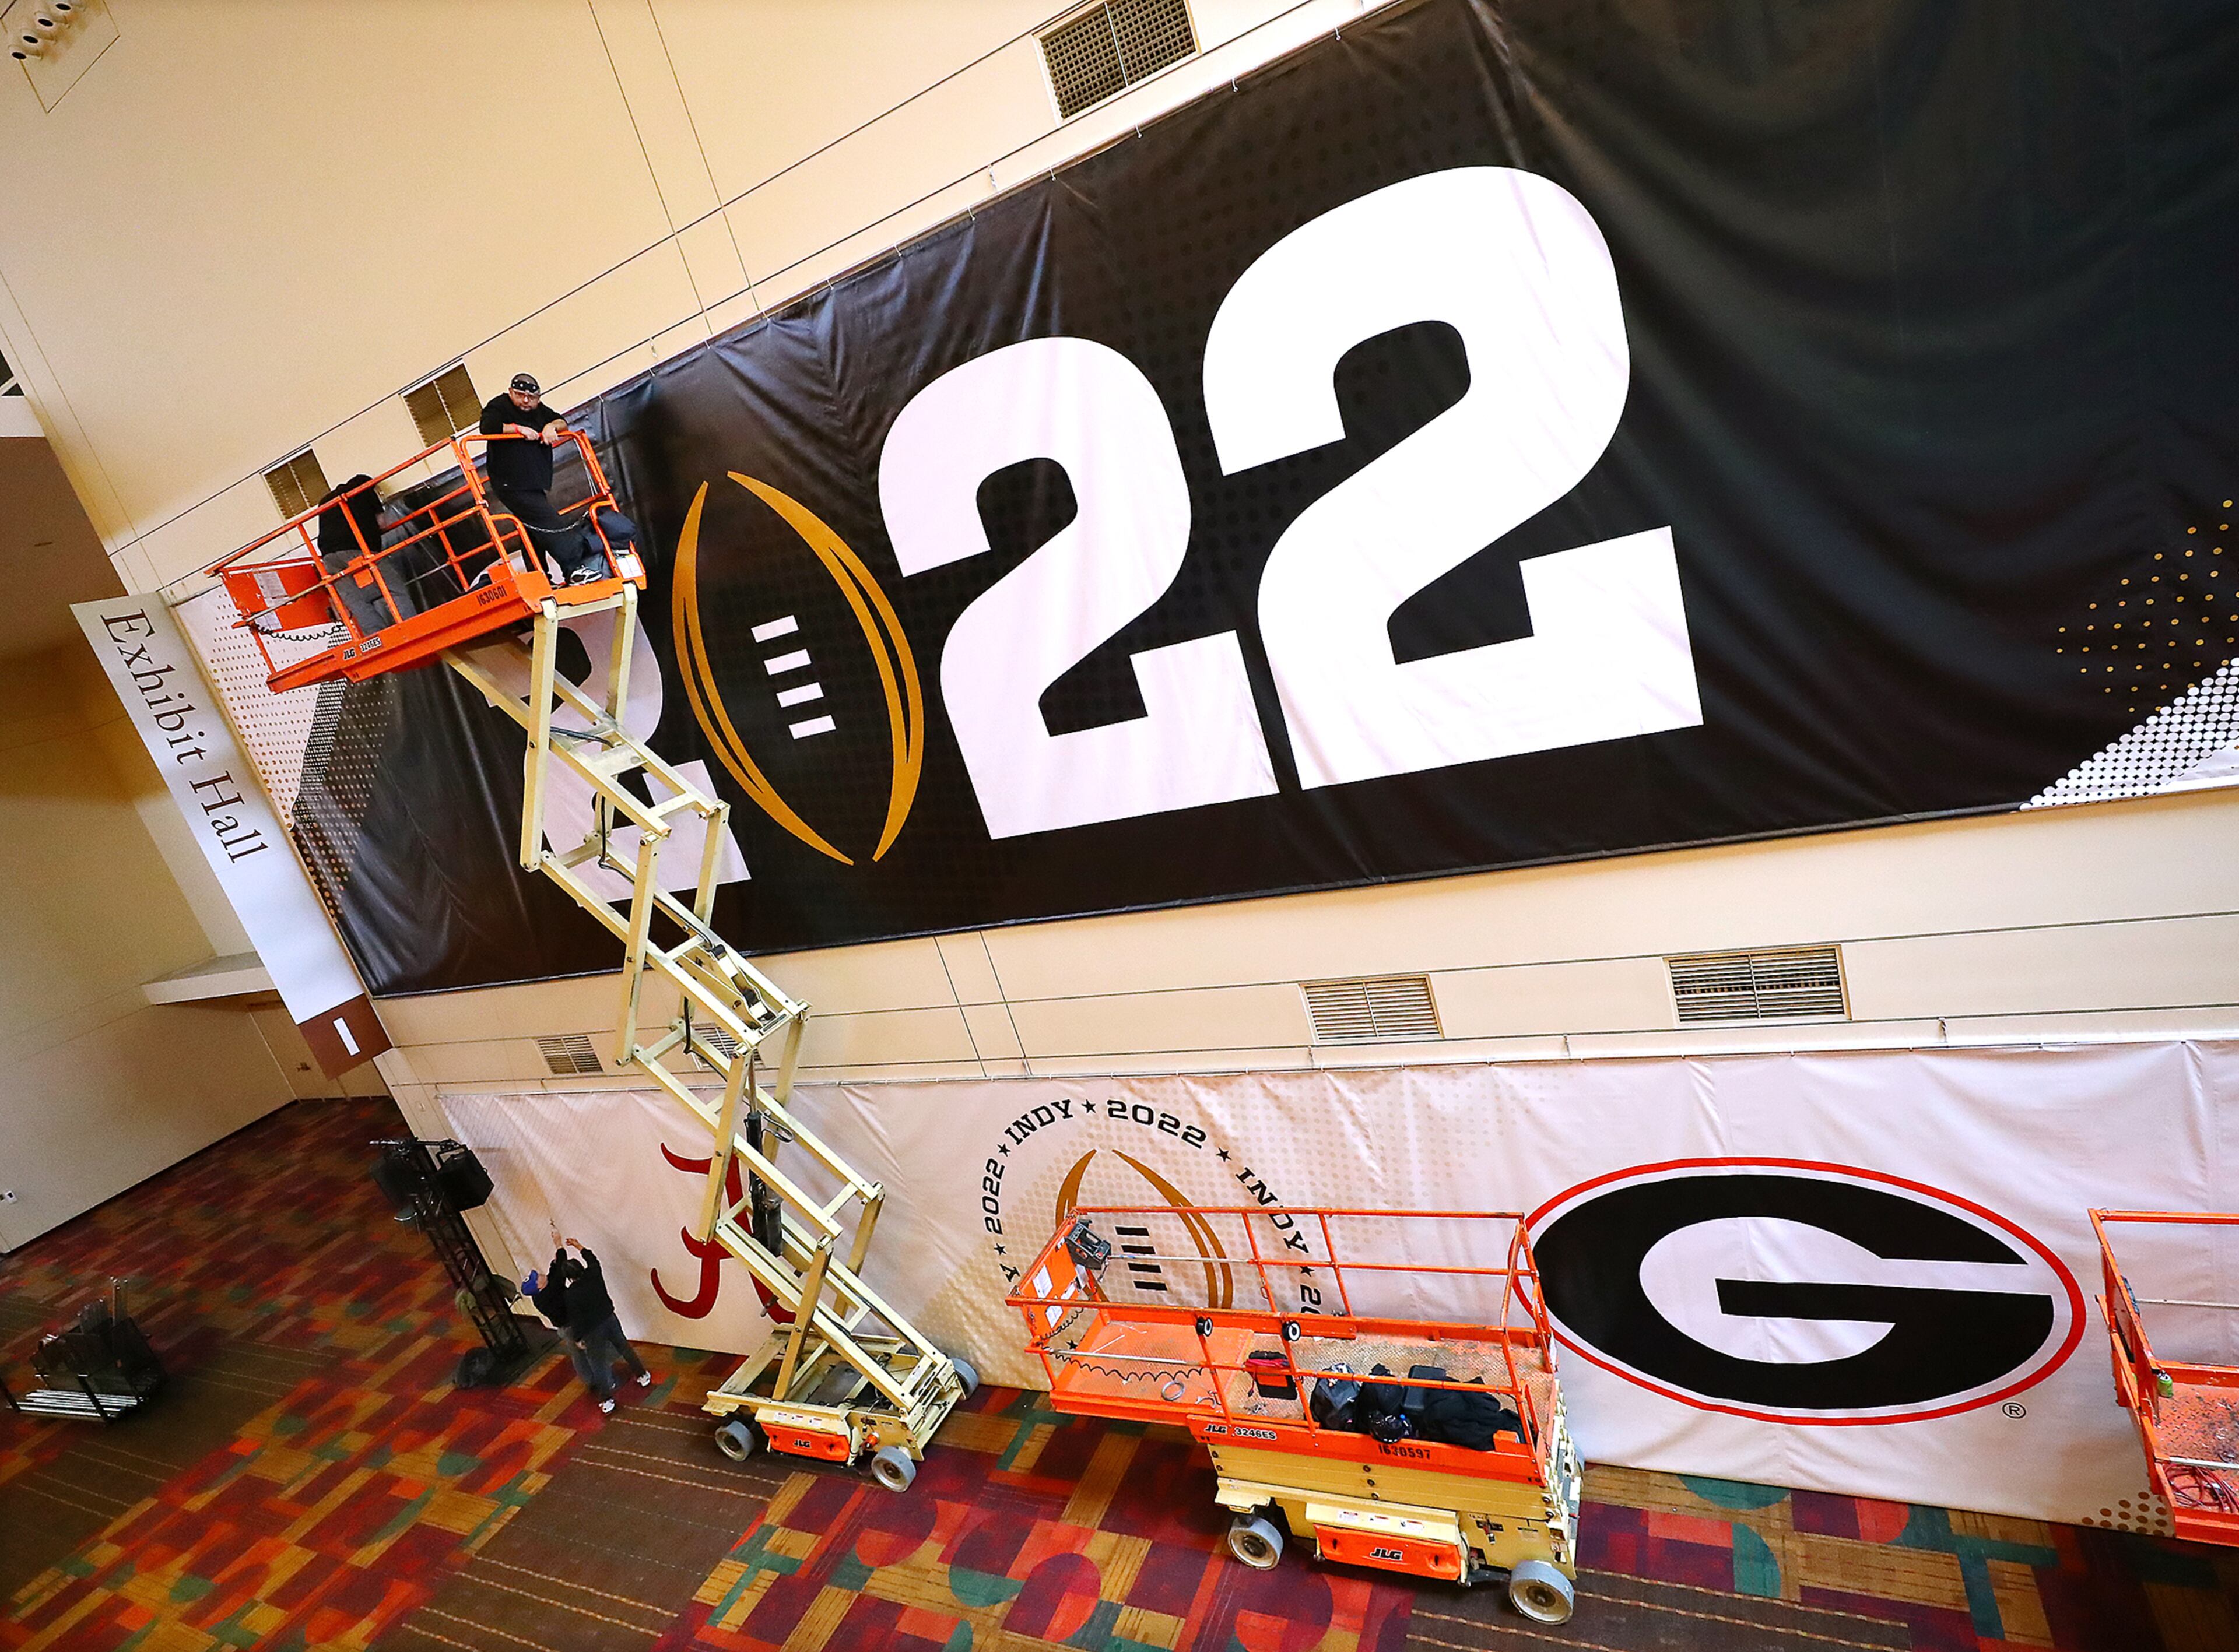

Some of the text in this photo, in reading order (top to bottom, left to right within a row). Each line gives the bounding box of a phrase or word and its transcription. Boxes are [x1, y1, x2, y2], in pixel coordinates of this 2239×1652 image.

[476, 585, 508, 606] 1630601
[343, 648, 356, 659] JLG
[100, 609, 269, 864] Exhibit Hall
[982, 1099, 1310, 1253] 2022 INDY 2022 INDY
[1204, 1424, 1277, 1440] JLG 3246ES
[793, 1438, 812, 1448] JLG
[1378, 1444, 1430, 1460] 1630597
[1370, 1548, 1403, 1561] JLG
